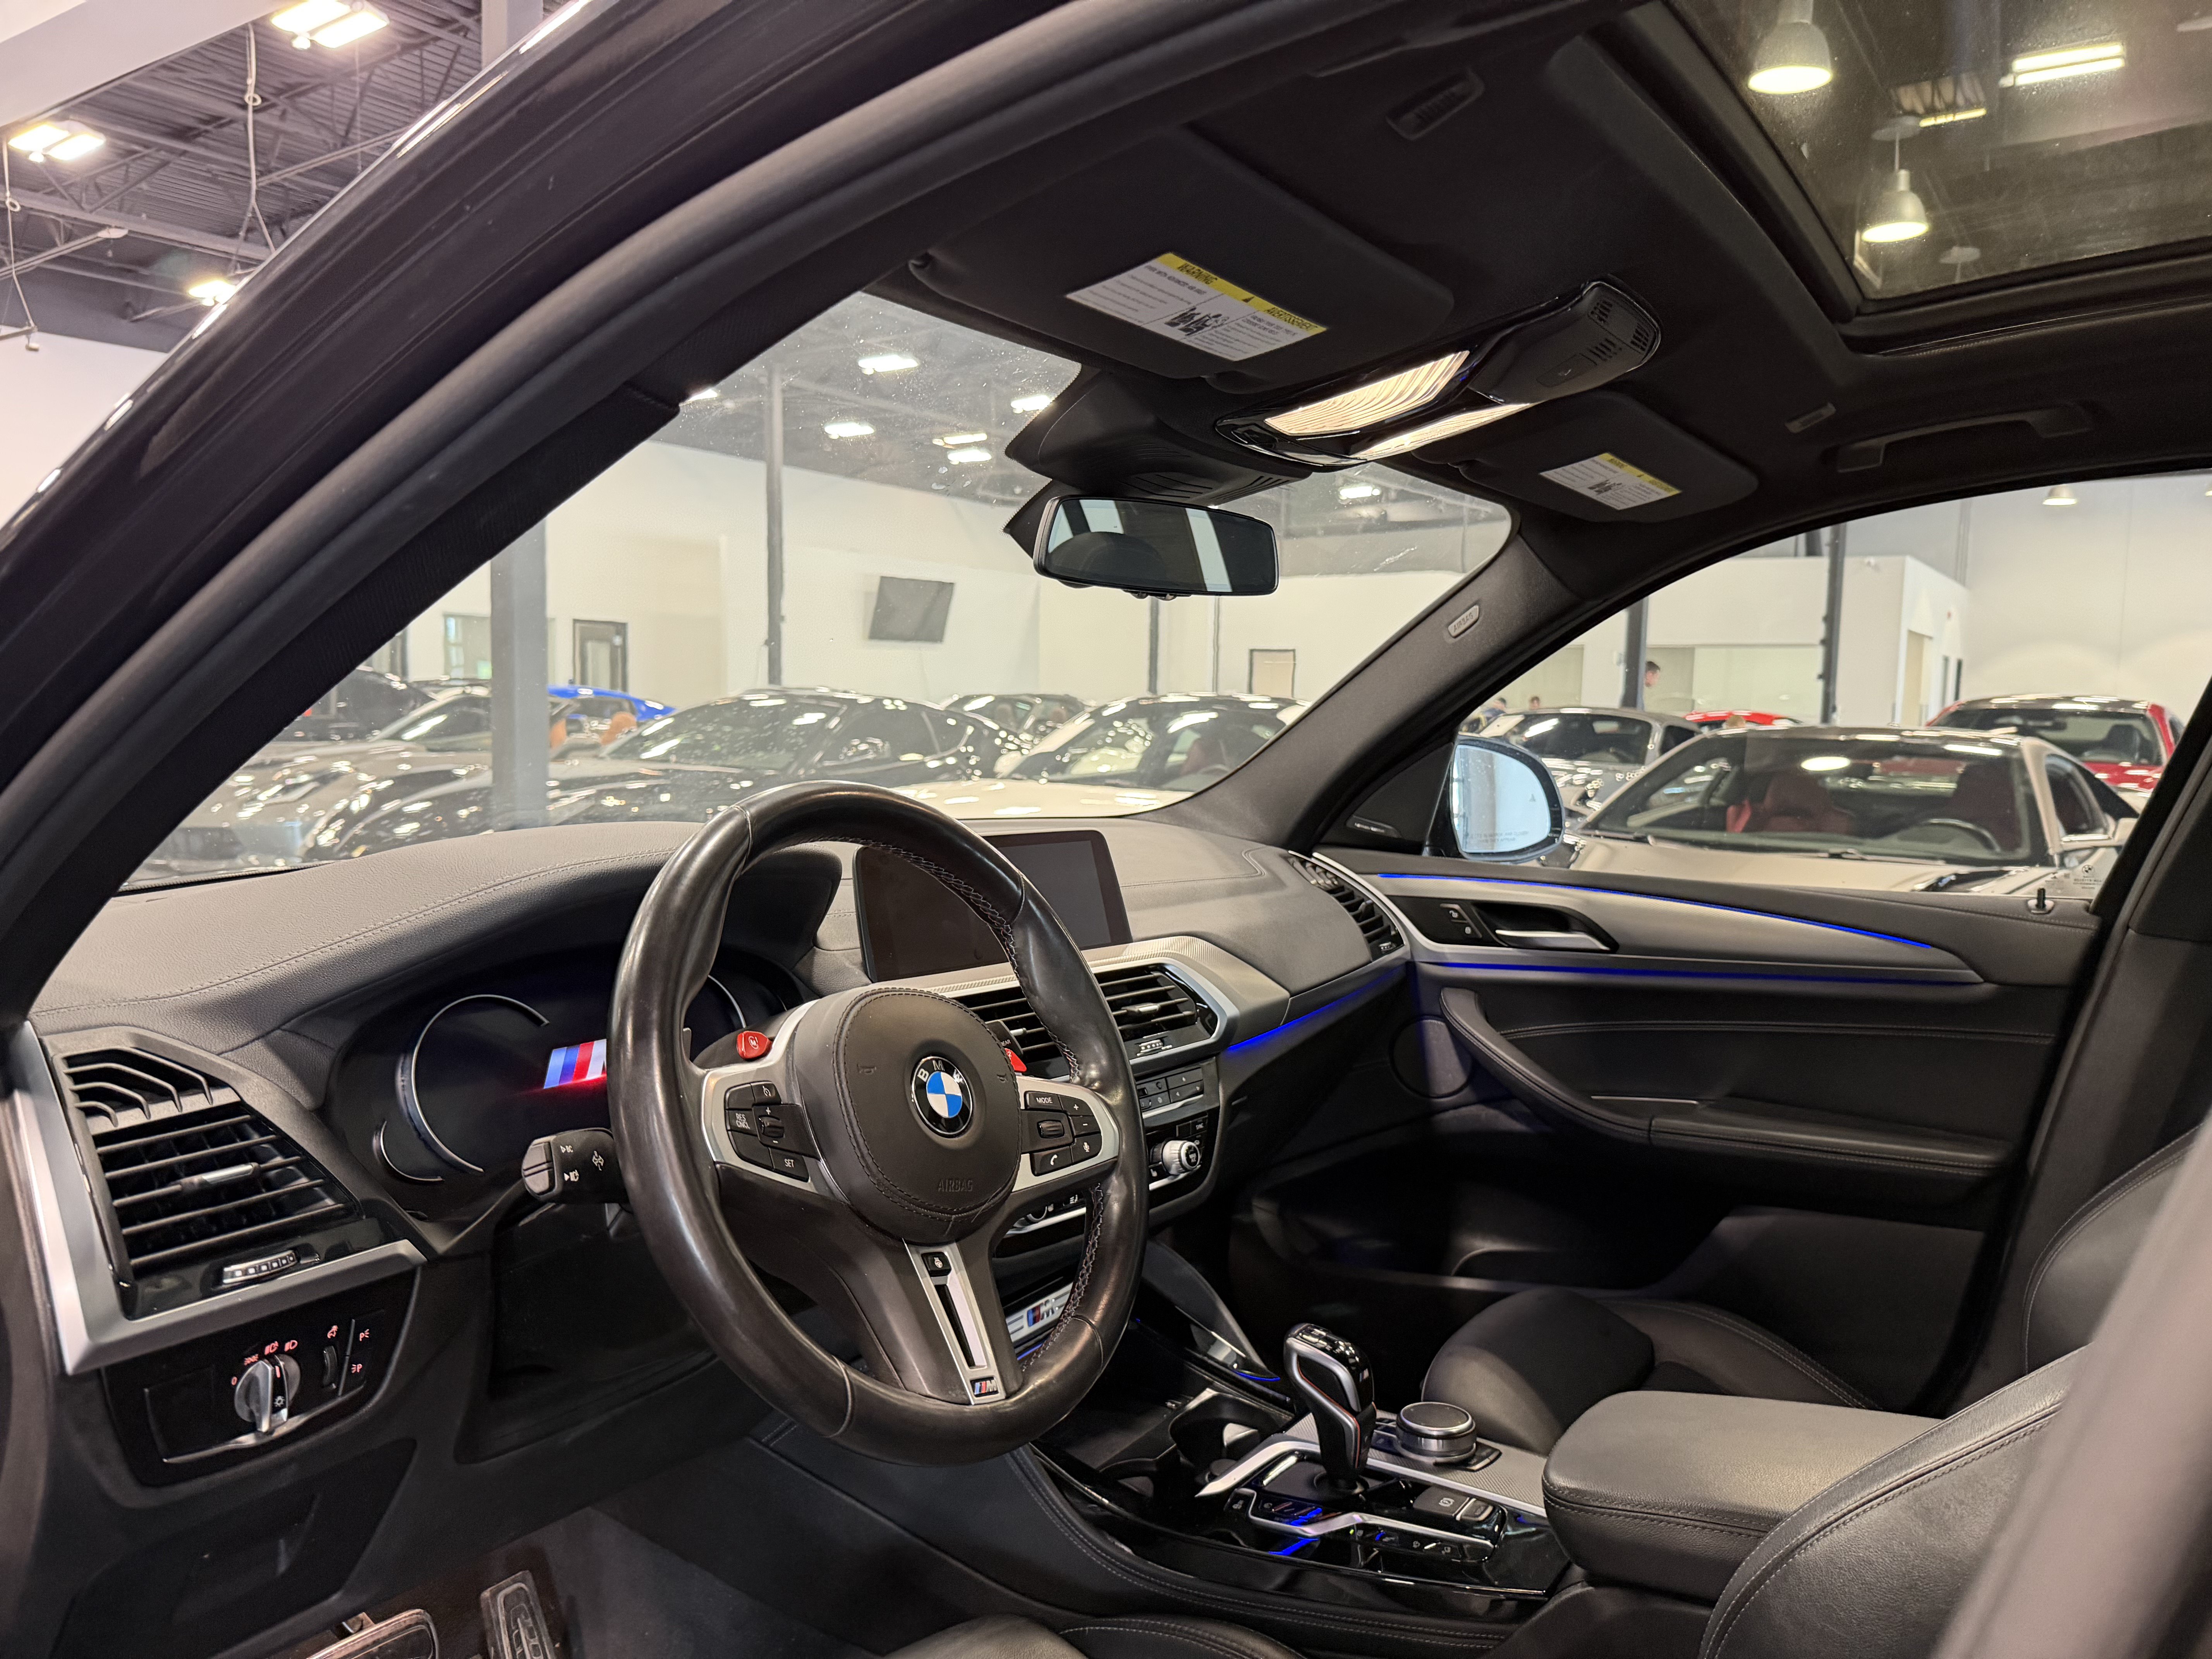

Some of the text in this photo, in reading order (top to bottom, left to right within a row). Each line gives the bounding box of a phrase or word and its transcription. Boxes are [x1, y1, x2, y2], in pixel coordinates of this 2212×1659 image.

[1177, 263, 1218, 285] WARNING
[1454, 612, 1474, 632] AIRBAG
[917, 1060, 964, 1084] BMW
[736, 1120, 750, 1130] CNCL
[784, 1158, 795, 1168] SET
[938, 1178, 973, 1192] AIRBAG
